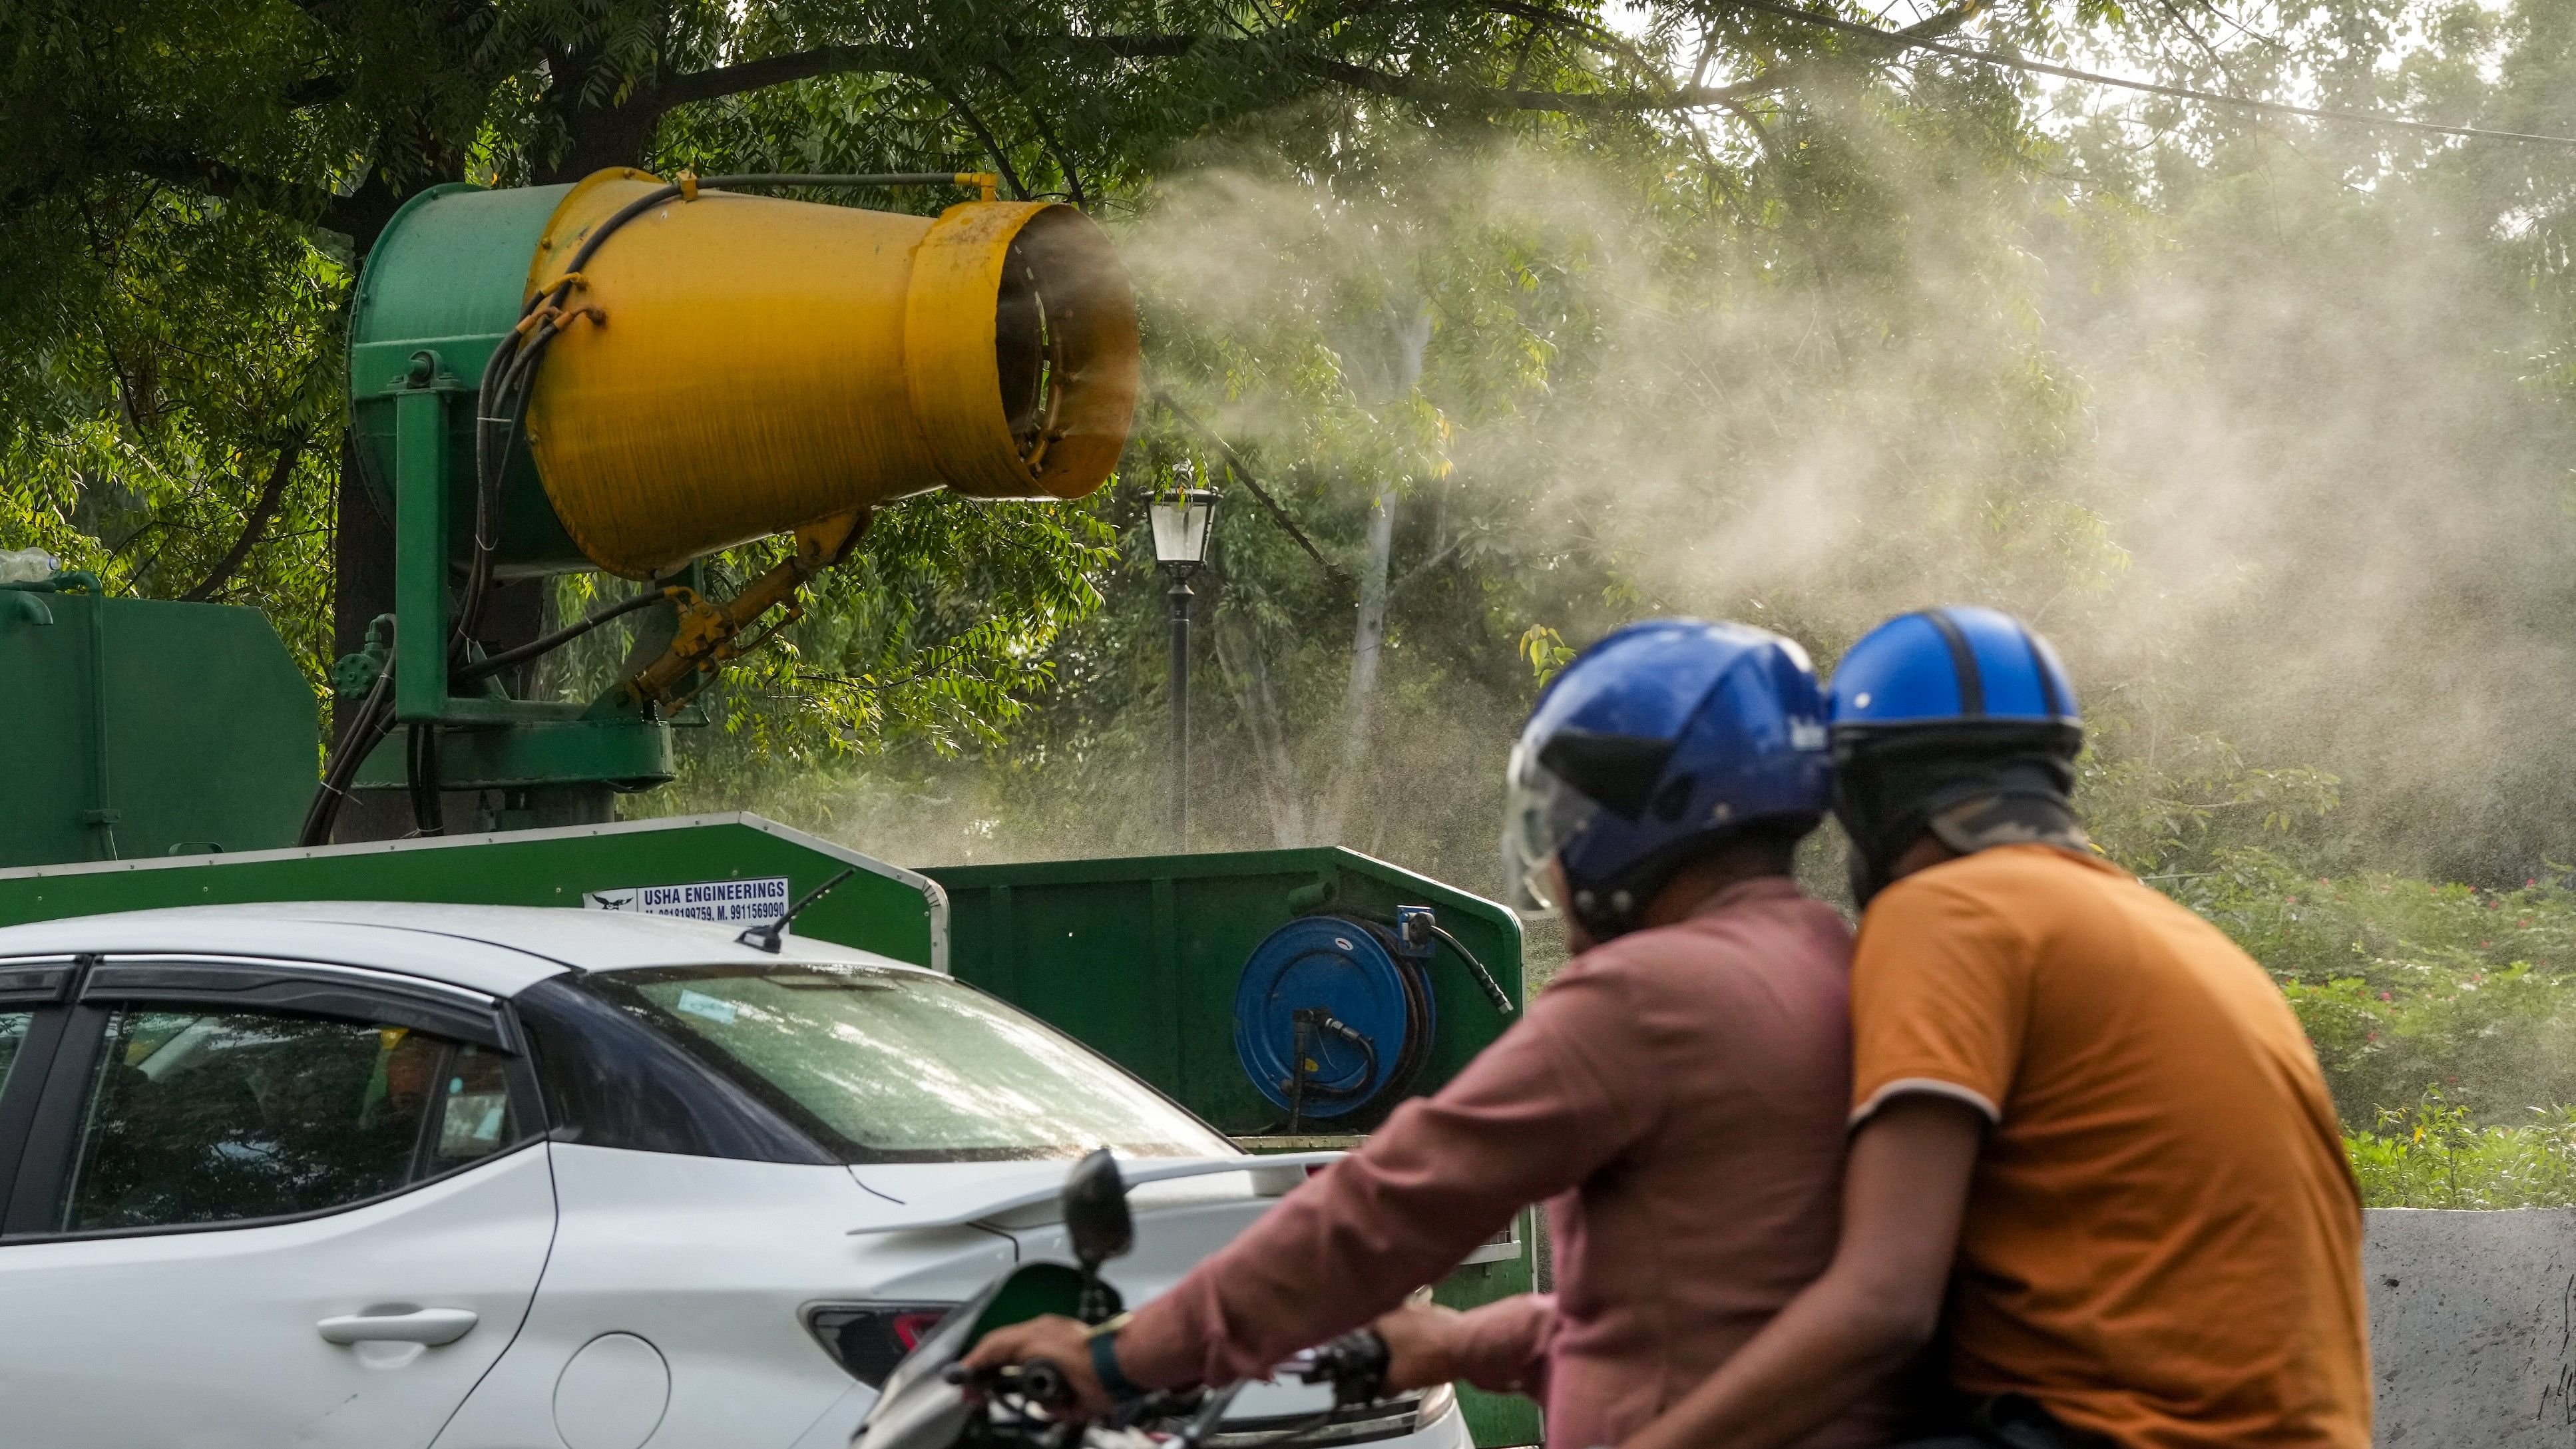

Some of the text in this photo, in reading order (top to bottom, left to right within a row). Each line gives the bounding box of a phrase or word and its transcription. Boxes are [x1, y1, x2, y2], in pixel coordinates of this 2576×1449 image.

[645, 882, 785, 905] USHA ENGINEERINGS
[717, 906, 728, 920] M.
[731, 902, 784, 920] 9911569090
